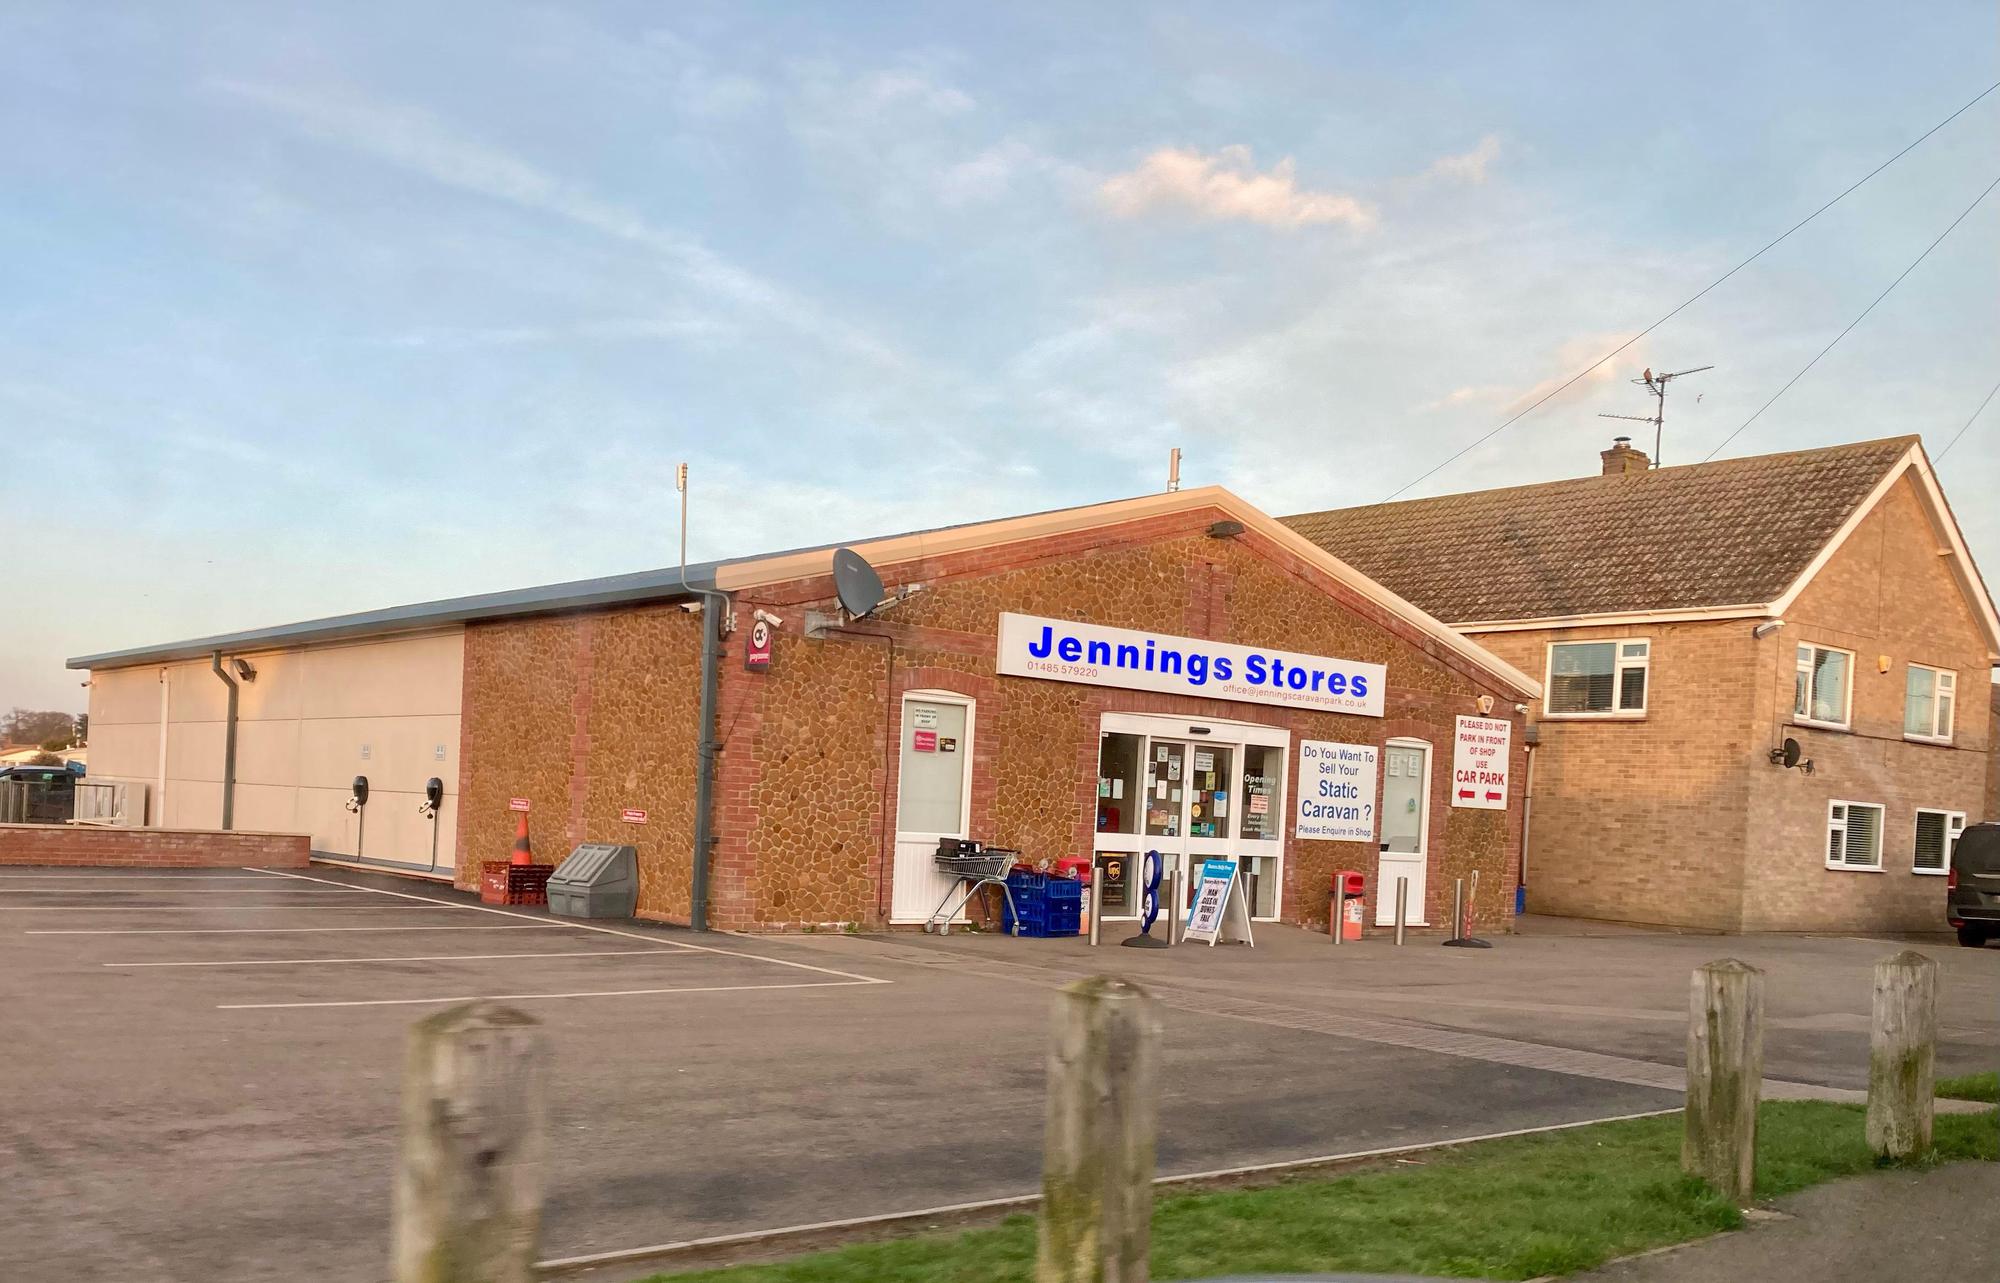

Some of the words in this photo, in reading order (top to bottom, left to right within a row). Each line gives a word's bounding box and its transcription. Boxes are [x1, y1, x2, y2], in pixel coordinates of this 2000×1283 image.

[1028, 626, 1233, 685] Jennings
[1245, 654, 1368, 698] Stores
[1027, 661, 1059, 673] 01485
[1061, 665, 1098, 678] 579220
[1460, 719, 1483, 730] PLEASE
[1484, 722, 1493, 730] DO
[1494, 723, 1507, 732] NOT
[1460, 733, 1476, 743] PARK
[1486, 736, 1506, 745] FRONT
[1304, 745, 1317, 758] Do
[1319, 747, 1336, 760] You
[1340, 749, 1361, 762] Want
[1364, 751, 1374, 763] To
[1469, 747, 1478, 755] OF
[1480, 748, 1496, 757] SHOP
[1319, 762, 1336, 774] Sell
[1339, 764, 1359, 776] Your
[1476, 761, 1488, 769] USE
[1244, 774, 1276, 786] Opening
[1456, 769, 1476, 784] CAR
[1480, 772, 1504, 786] PARK
[1248, 785, 1271, 795] Times
[1319, 779, 1358, 799] Static
[1301, 799, 1359, 820] Caravan
[1364, 804, 1371, 821] ?
[1298, 824, 1320, 834] Please
[1322, 826, 1346, 836] Enquire
[1355, 828, 1371, 838] Shop
